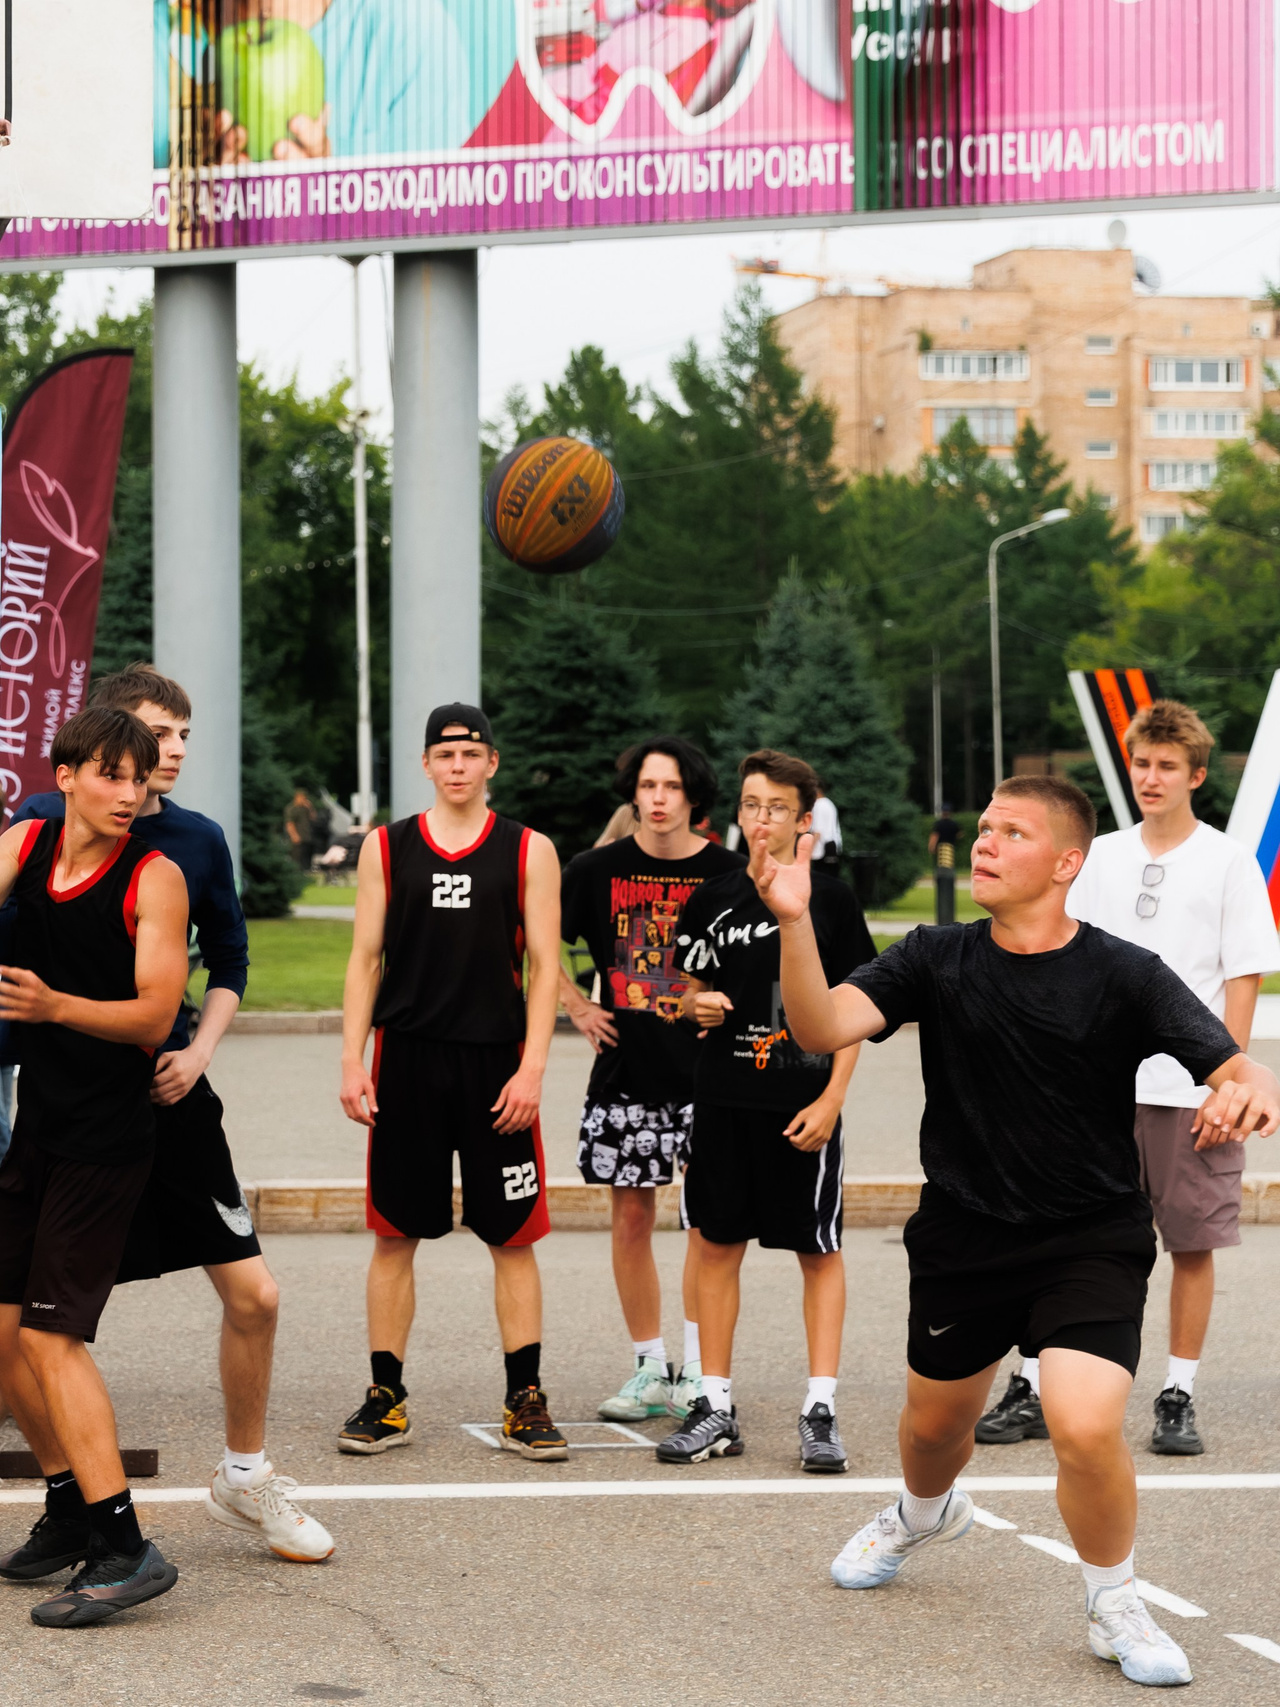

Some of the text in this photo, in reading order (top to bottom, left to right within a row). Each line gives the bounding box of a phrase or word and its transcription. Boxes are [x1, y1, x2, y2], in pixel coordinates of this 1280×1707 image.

[308, 163, 508, 218] НЕОБХОДИМО
[960, 120, 1225, 183] СПЕЦИАЛИСТОМ
[432, 873, 472, 909] 22
[609, 877, 665, 914] HORROR
[502, 1161, 539, 1201] 22
